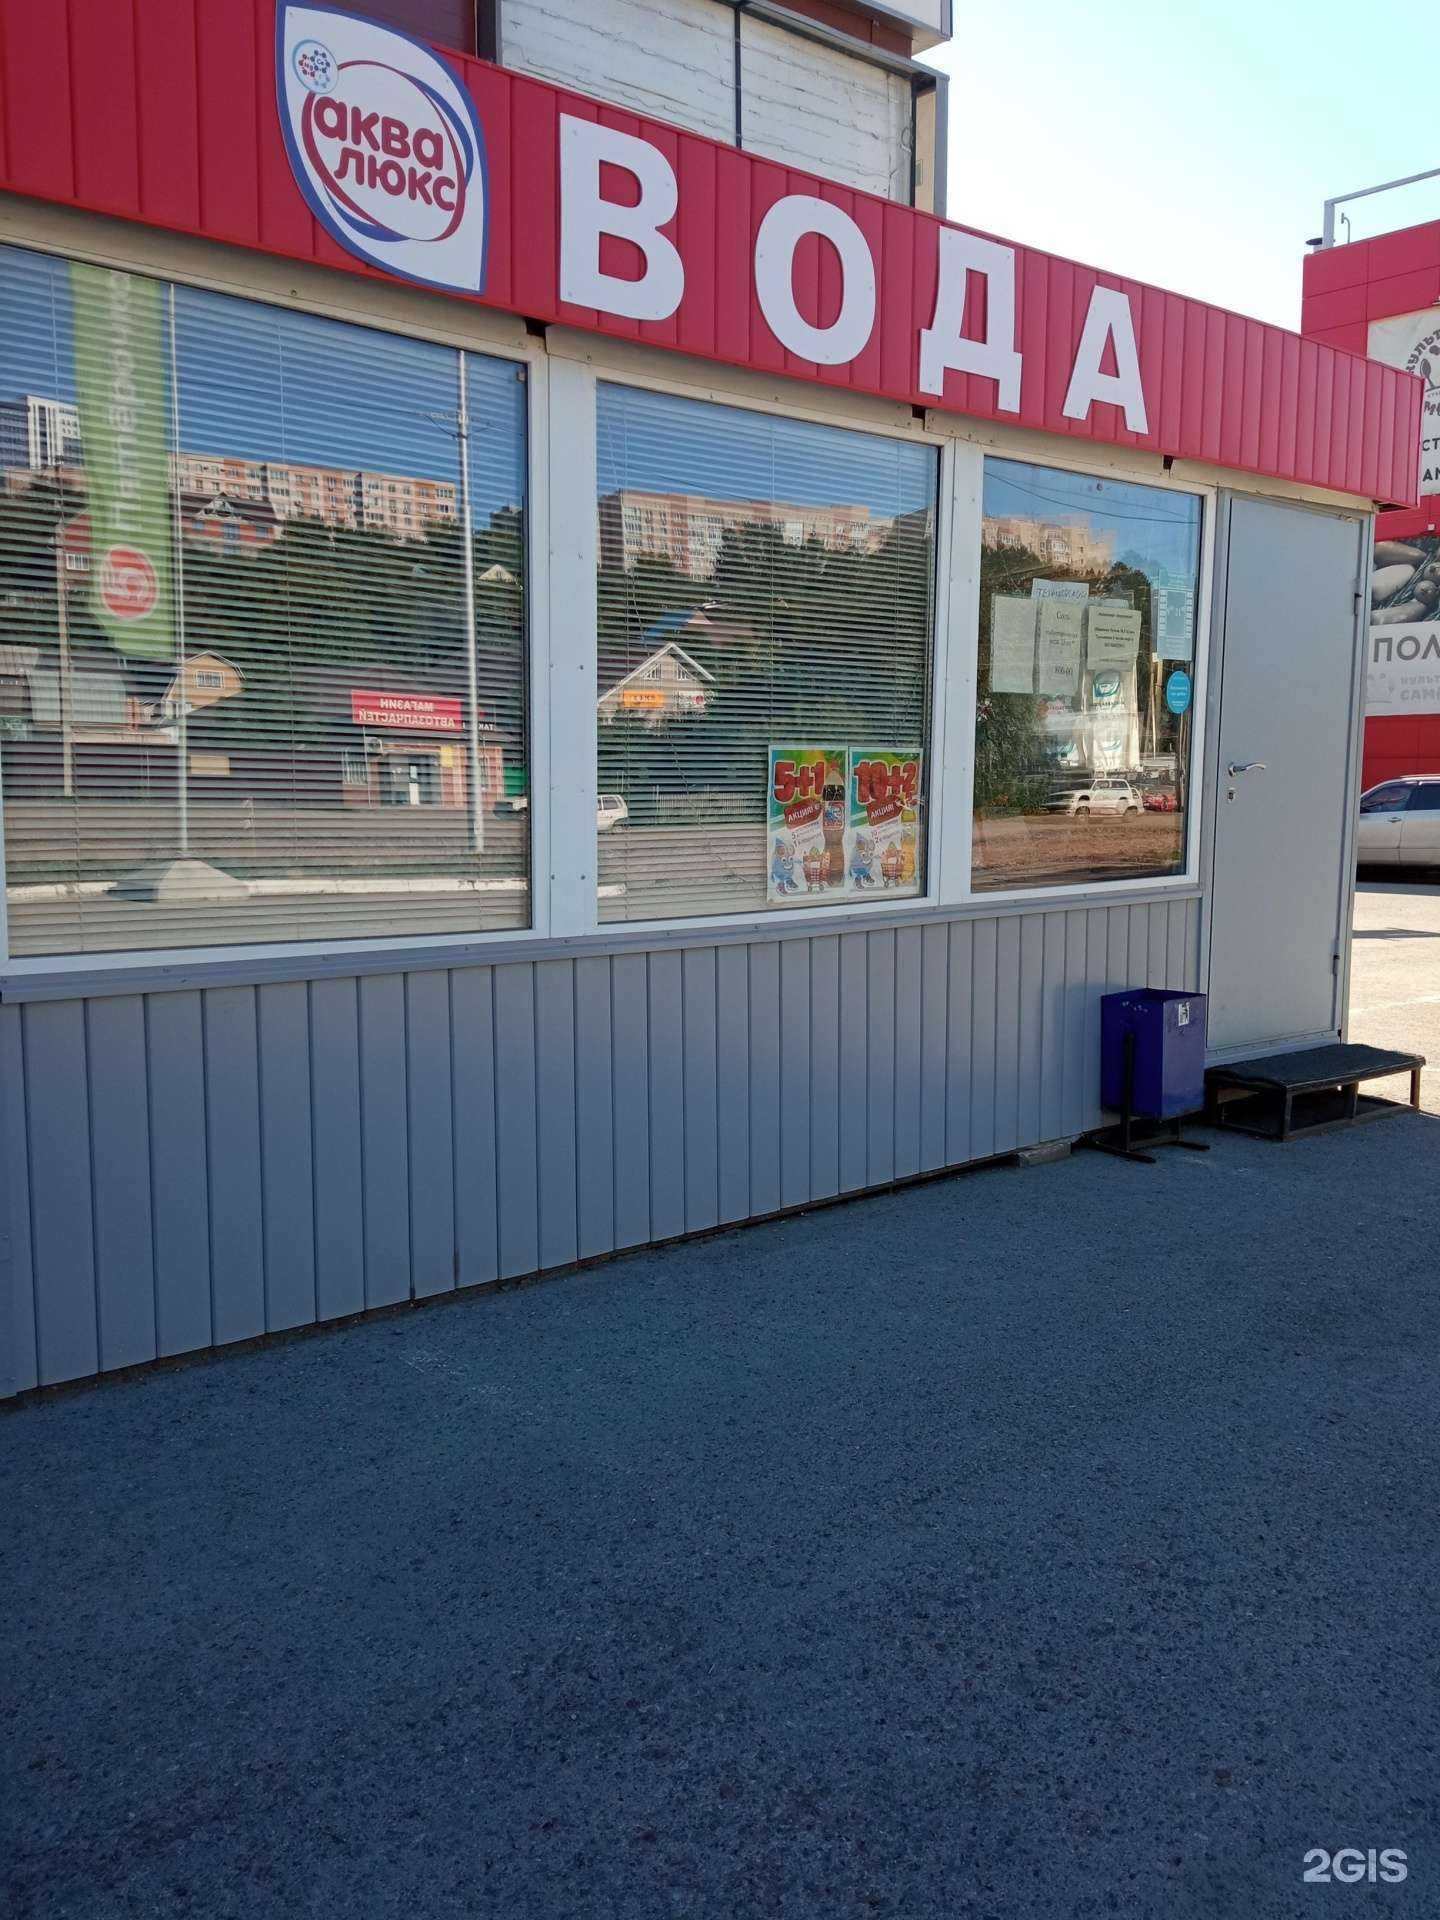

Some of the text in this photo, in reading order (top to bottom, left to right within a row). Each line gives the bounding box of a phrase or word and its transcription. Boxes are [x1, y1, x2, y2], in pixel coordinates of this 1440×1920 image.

[559, 112, 1149, 435] ВОДА
[773, 760, 826, 804] 5+1
[853, 760, 918, 805] 10+2
